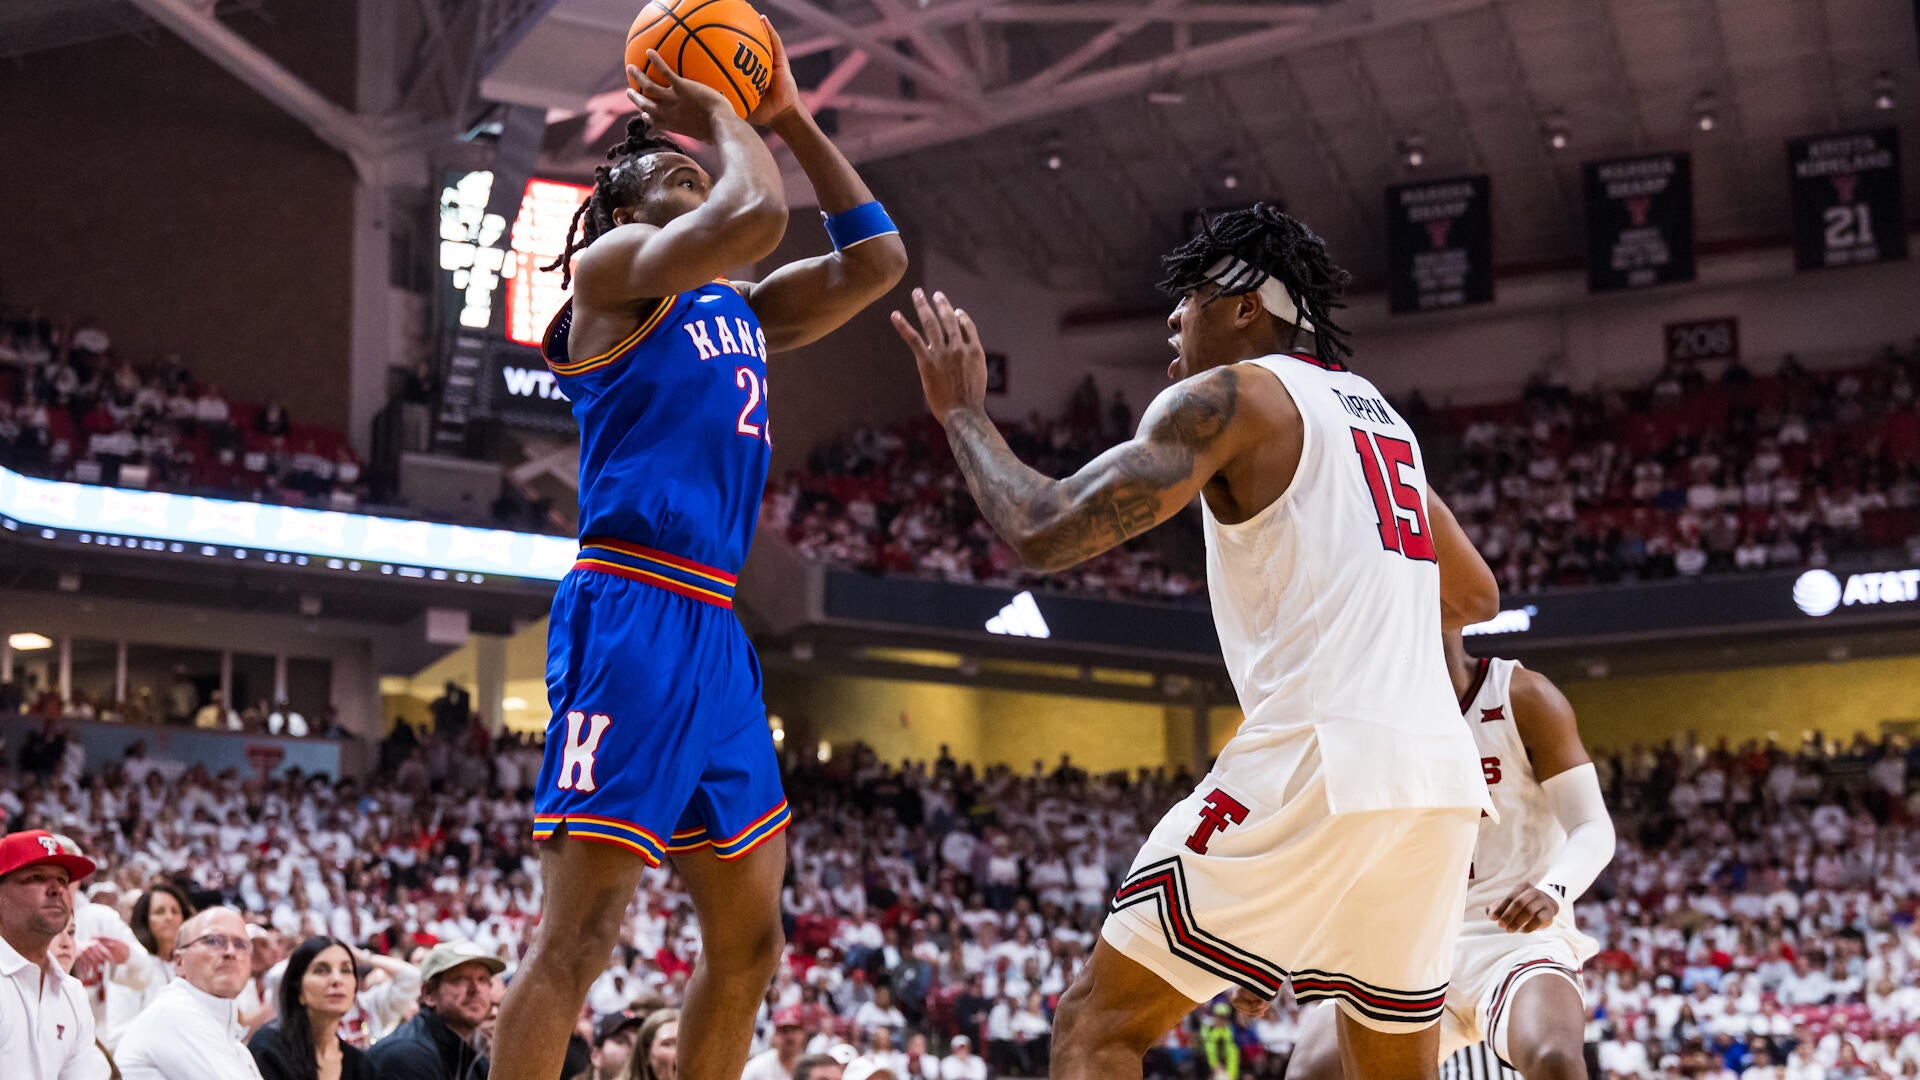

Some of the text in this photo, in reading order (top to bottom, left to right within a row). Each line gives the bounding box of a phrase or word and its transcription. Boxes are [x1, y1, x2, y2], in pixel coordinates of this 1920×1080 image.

[1823, 204, 1873, 247] 21
[1670, 326, 1730, 356] 208
[1350, 426, 1437, 564] 15
[1842, 569, 1920, 606] AT&T
